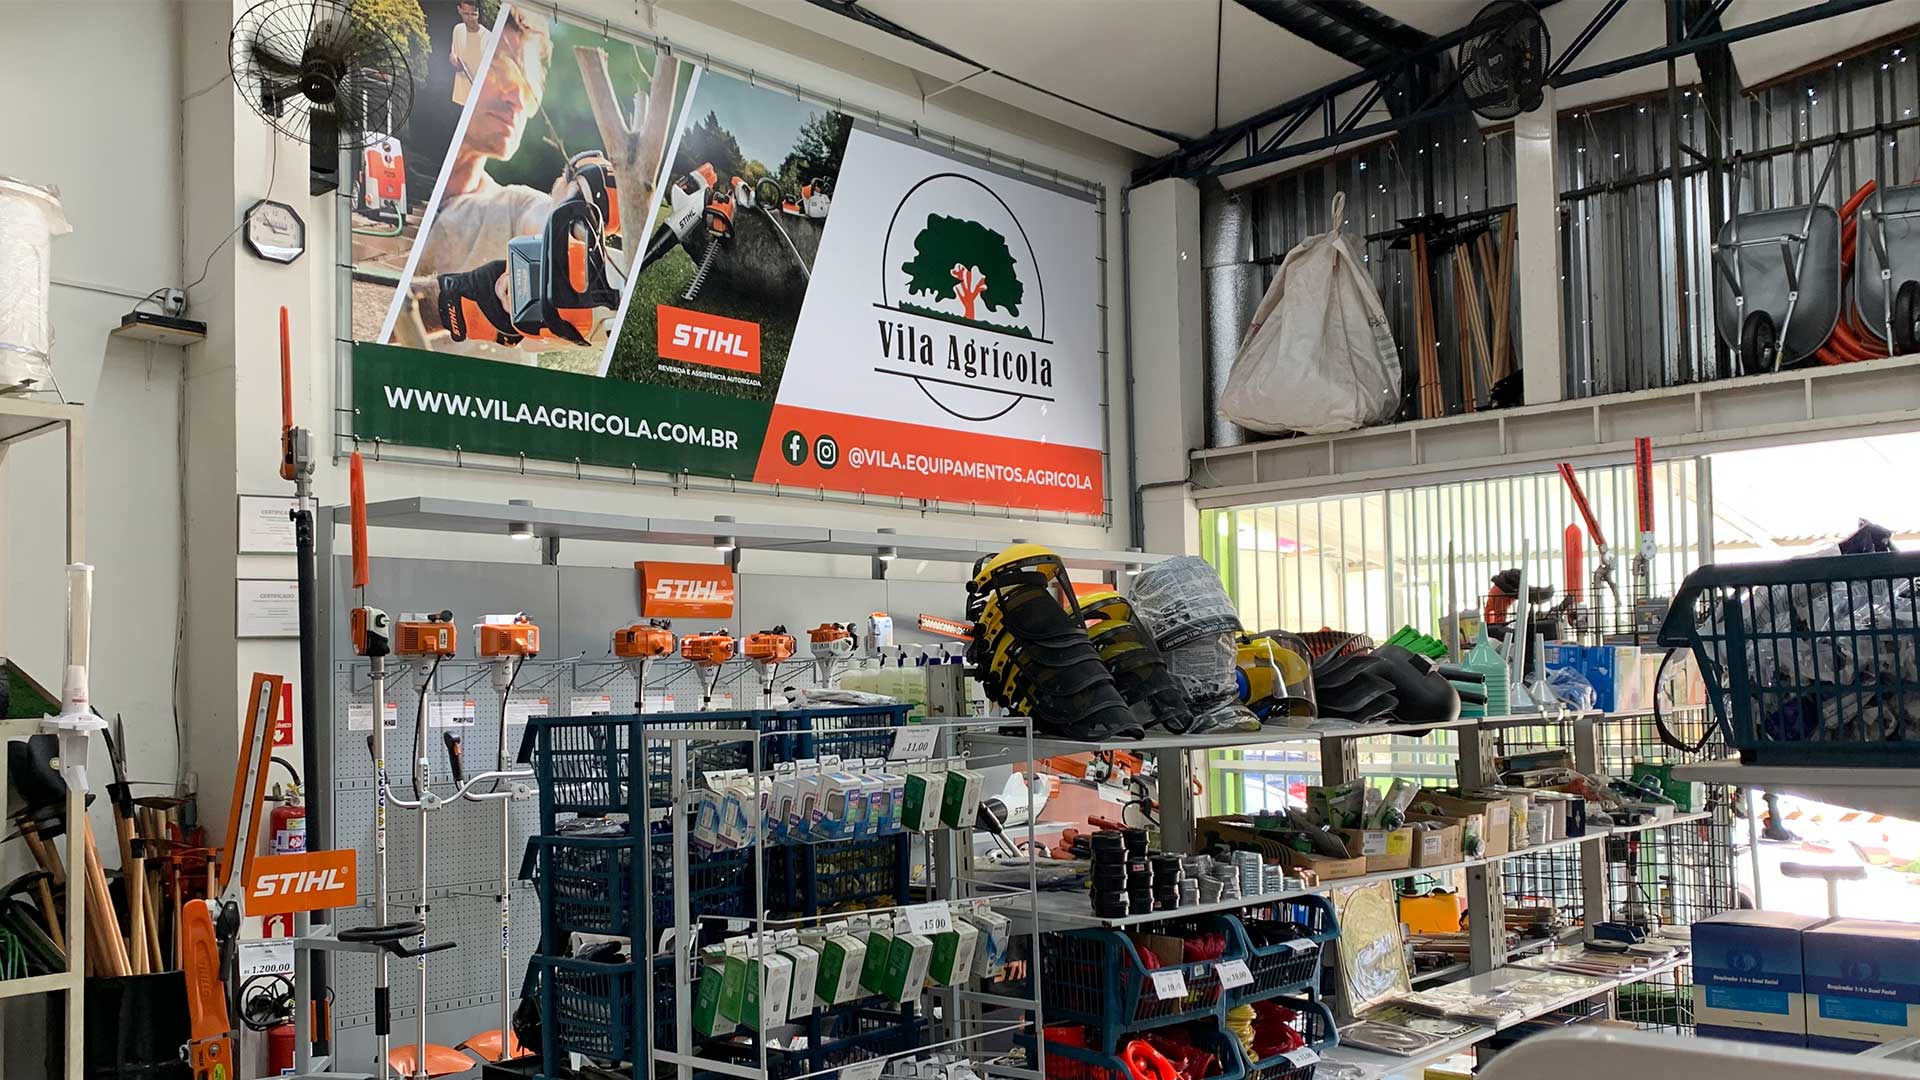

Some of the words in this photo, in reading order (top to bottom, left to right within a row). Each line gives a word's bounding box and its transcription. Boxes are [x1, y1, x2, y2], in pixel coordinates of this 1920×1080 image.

[679, 209, 697, 230] STIHL
[448, 304, 461, 337] STIHL
[672, 323, 749, 357] STIHL
[878, 319, 934, 366] Vila
[947, 334, 1053, 387] Agrícola
[658, 364, 686, 375] REVENDA
[687, 368, 691, 376] E
[691, 370, 726, 381] ASSISTÊNCIA
[727, 375, 762, 387] AUTORIZADA
[384, 385, 739, 449] WWW.VILAAGRICOLA.COM.BR
[848, 447, 1093, 490] @VILA.EQUIPAMENTOS.AGRICOLA
[654, 578, 724, 600] STIHL
[907, 742, 929, 752] 11,00
[253, 868, 345, 898] STIHL
[252, 963, 290, 974] 1.200,00
[993, 960, 1027, 984] STI
